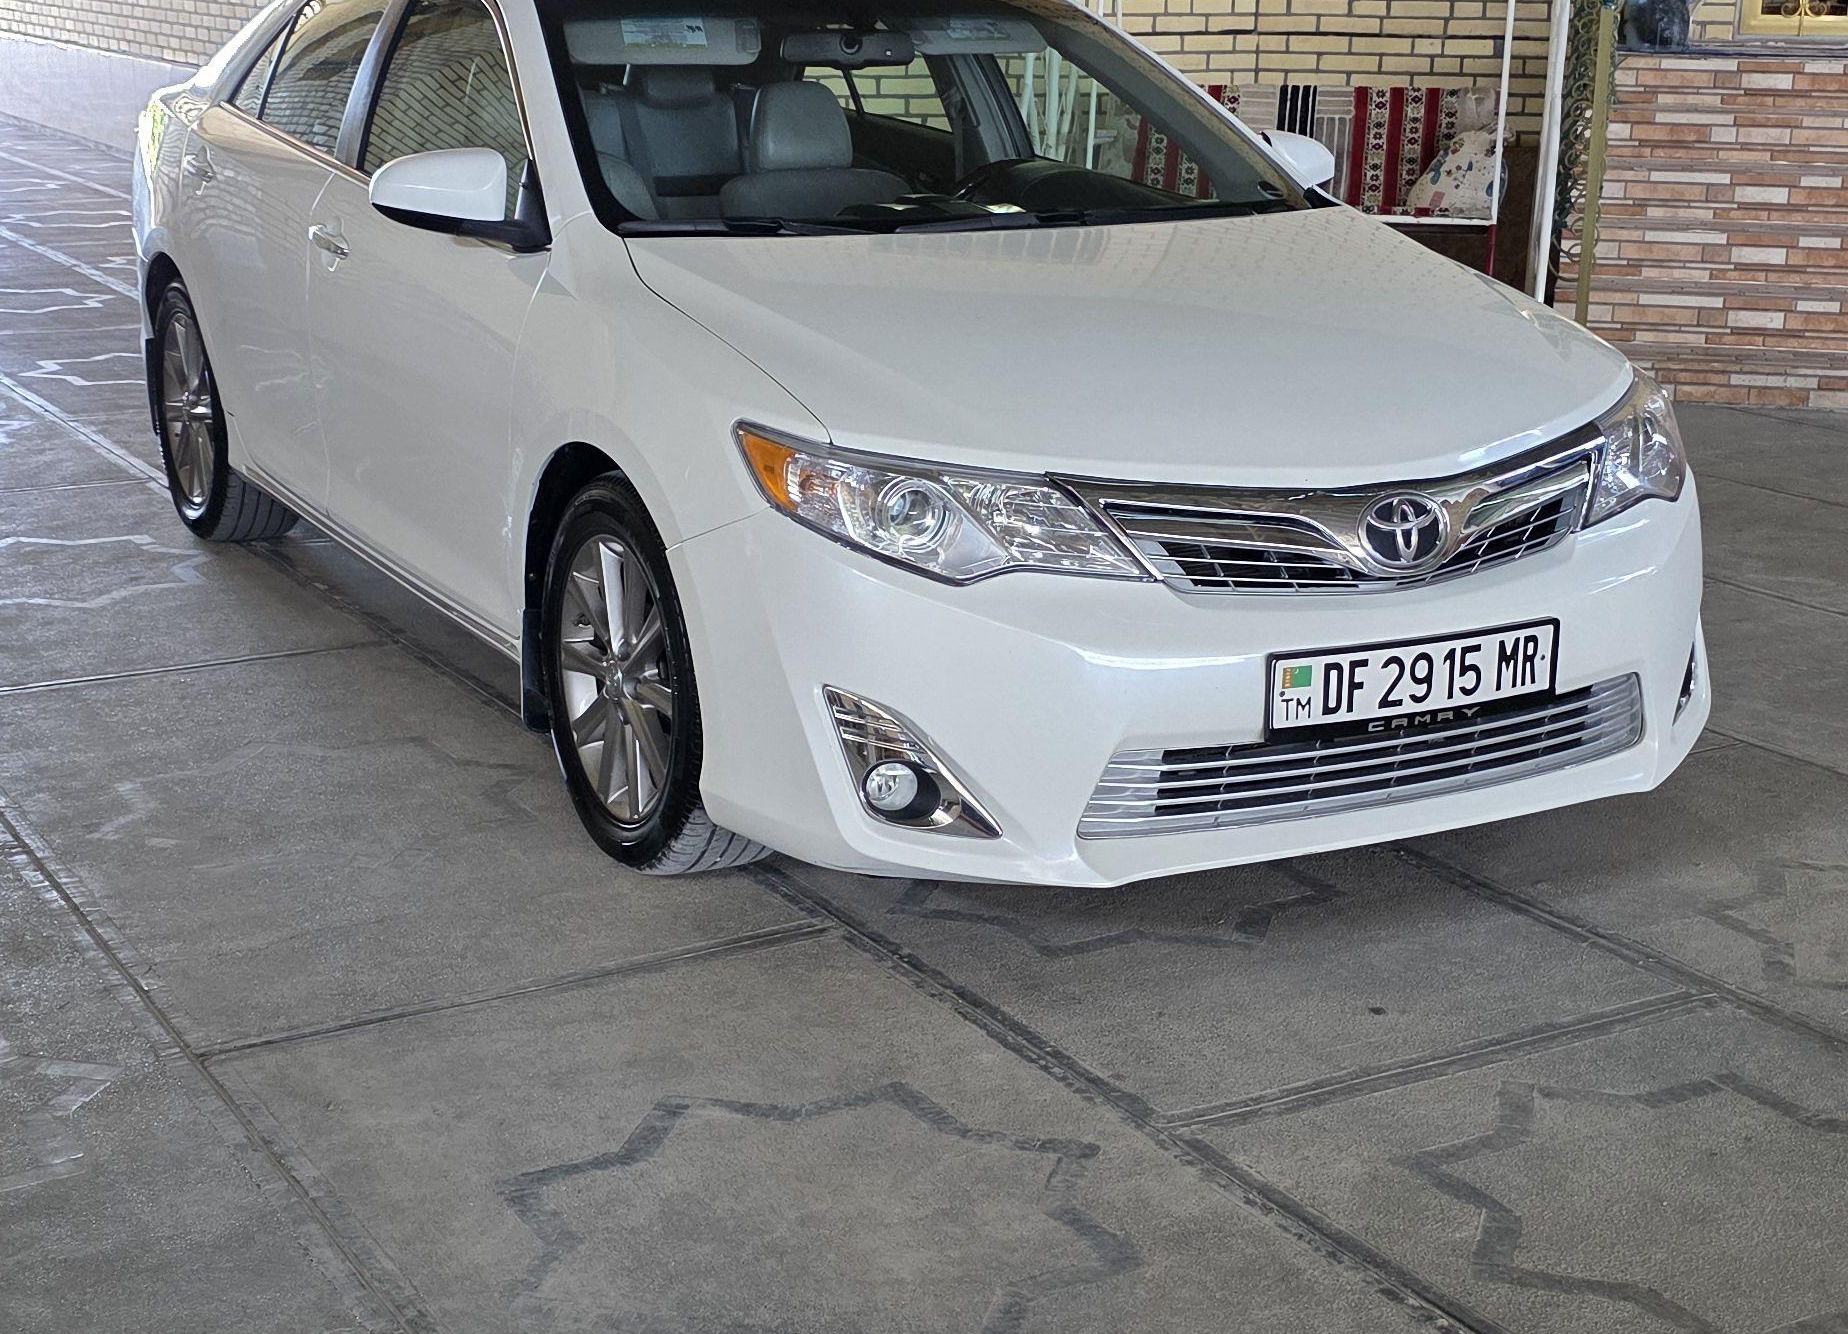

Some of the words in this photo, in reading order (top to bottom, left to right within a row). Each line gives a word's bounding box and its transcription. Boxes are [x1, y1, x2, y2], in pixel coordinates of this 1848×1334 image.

[1322, 659, 1369, 716] DF
[1378, 644, 1482, 709] 2915
[1495, 634, 1539, 692] MR
[1281, 697, 1312, 721] TM
[1368, 707, 1481, 732] CAMRY
